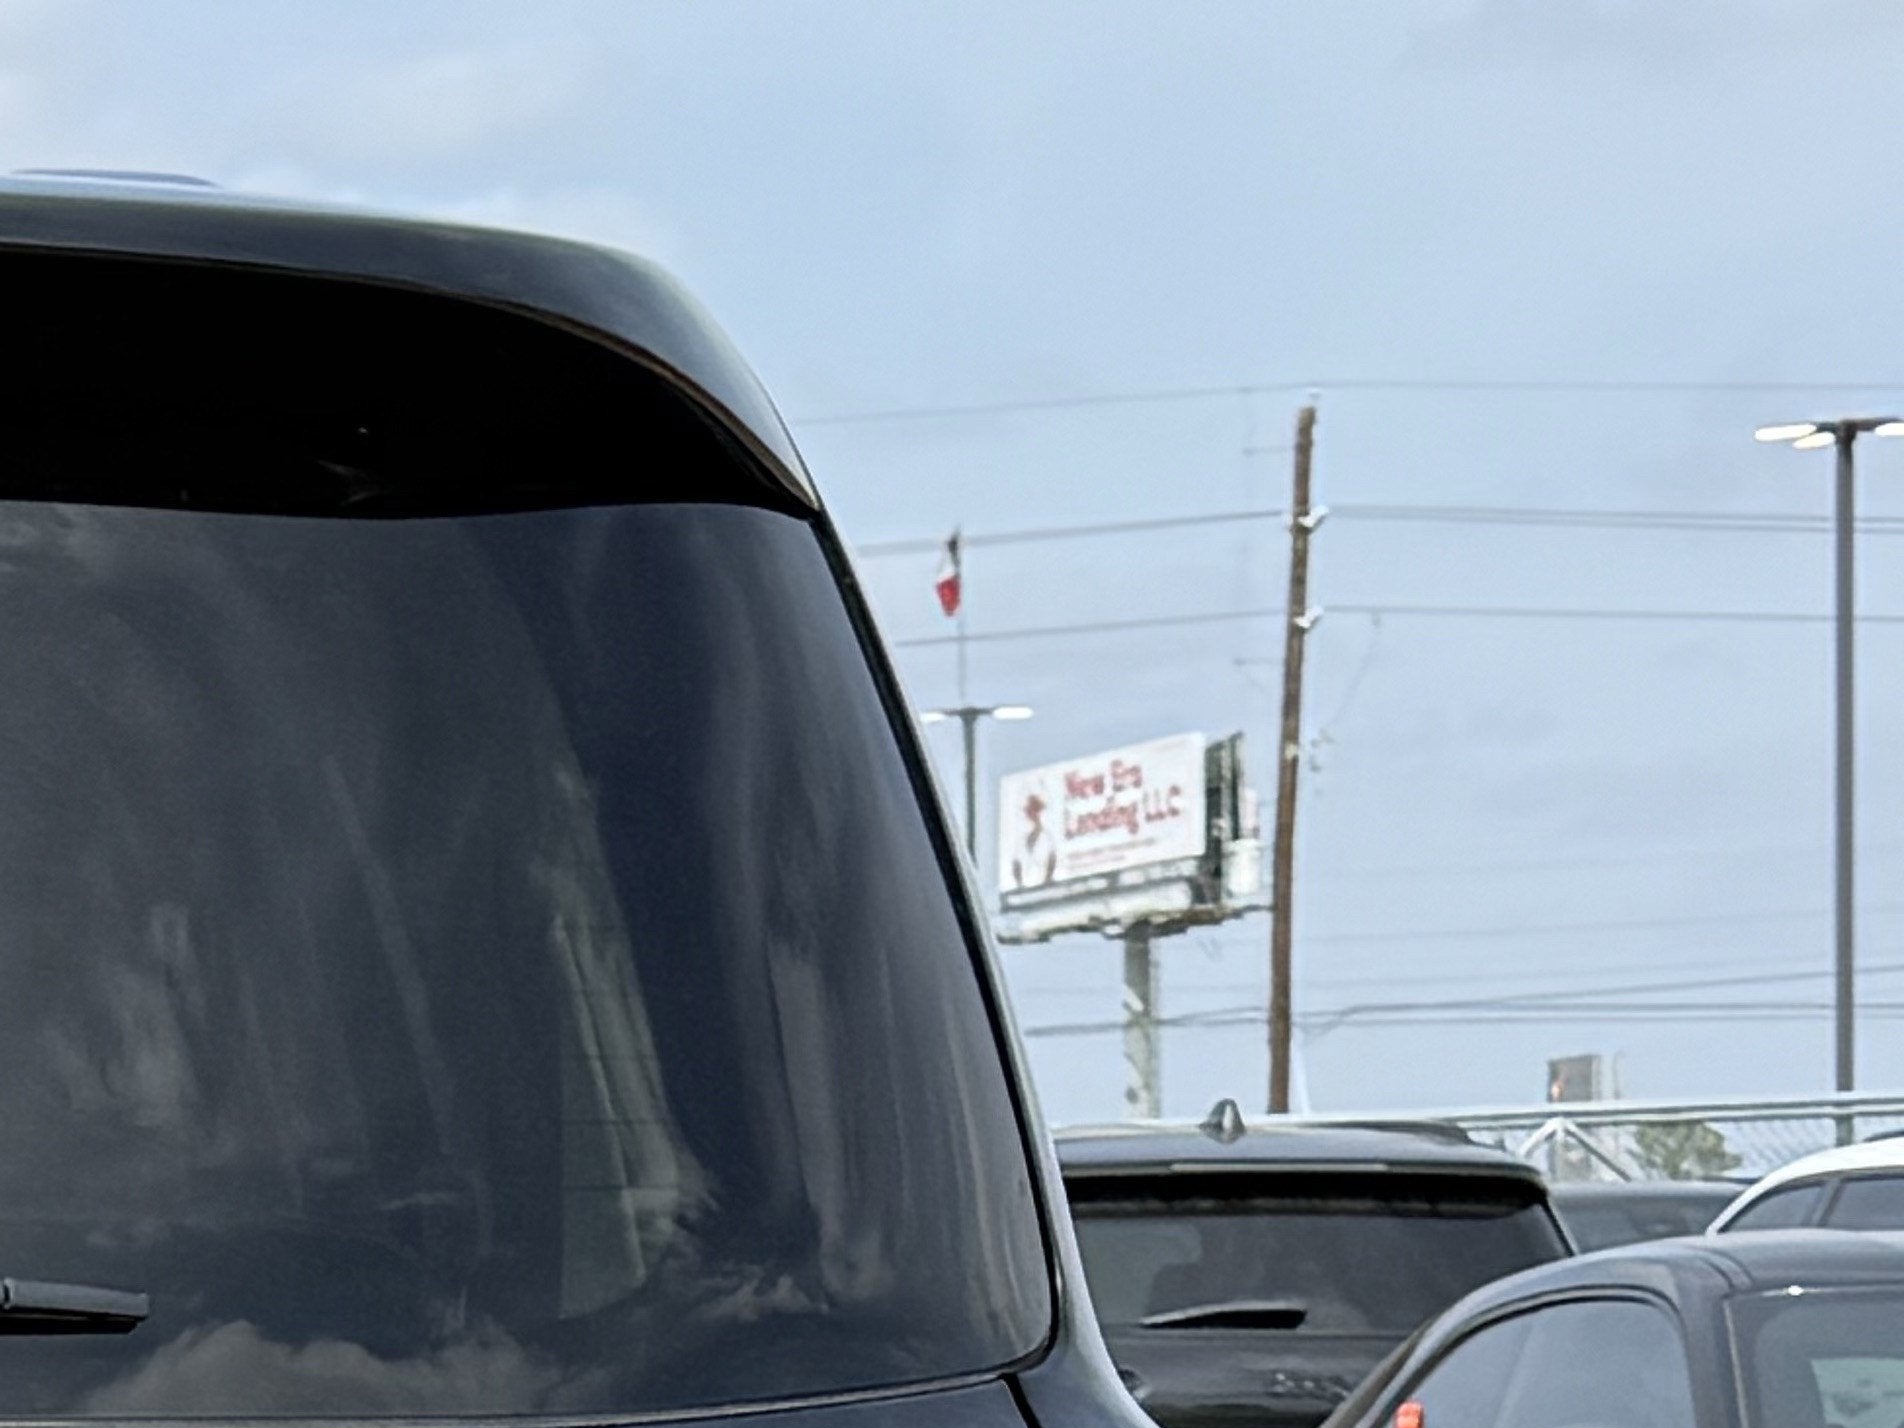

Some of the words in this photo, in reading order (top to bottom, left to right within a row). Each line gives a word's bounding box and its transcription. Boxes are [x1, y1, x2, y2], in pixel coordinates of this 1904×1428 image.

[1065, 769, 1105, 798] New
[1111, 759, 1142, 792] Era
[1142, 785, 1182, 822] LLC
